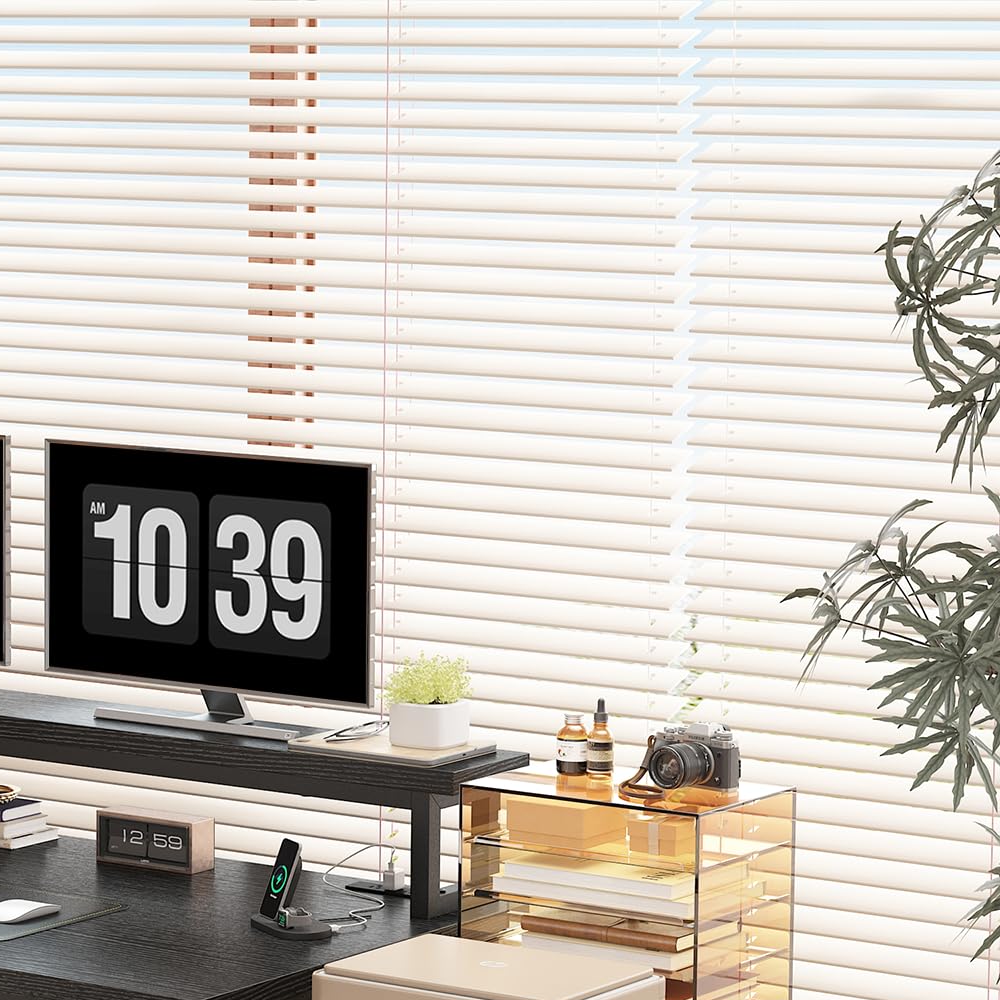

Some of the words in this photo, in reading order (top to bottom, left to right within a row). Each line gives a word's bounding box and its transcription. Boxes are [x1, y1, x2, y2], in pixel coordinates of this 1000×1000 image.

[89, 501, 106, 515] AM
[94, 504, 187, 626] 10
[215, 514, 323, 641] 39
[123, 828, 144, 845] 12
[153, 833, 183, 850] 59
